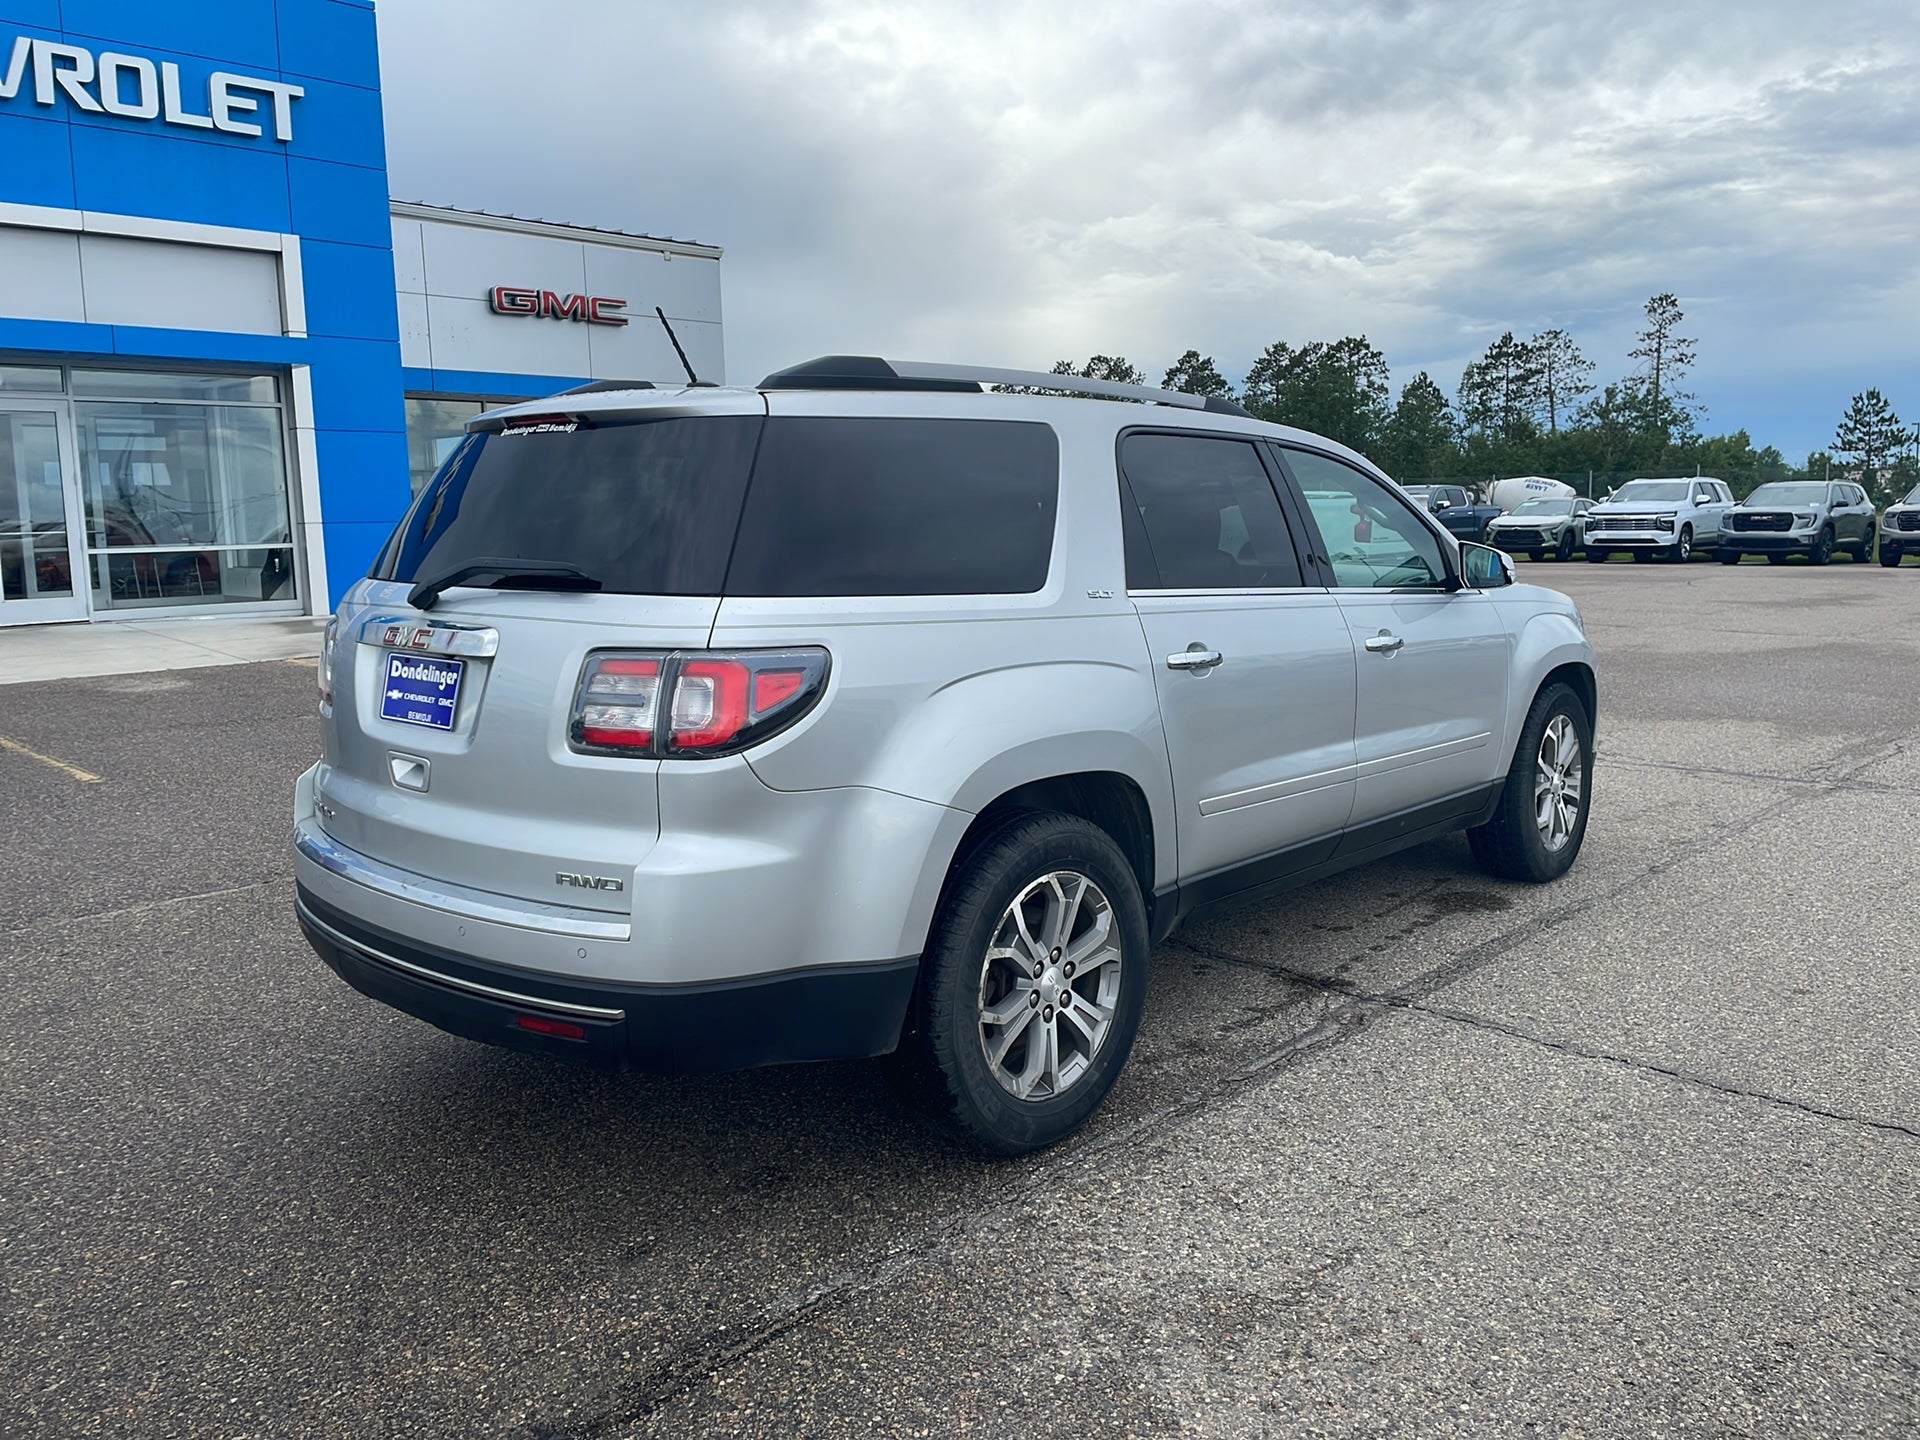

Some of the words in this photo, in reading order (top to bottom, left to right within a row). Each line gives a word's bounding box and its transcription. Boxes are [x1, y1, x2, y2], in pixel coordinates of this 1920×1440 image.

[490, 286, 628, 326] GMC
[1087, 590, 1114, 599] SLT
[383, 626, 434, 649] GMC
[390, 660, 458, 690] Dondelinger
[403, 693, 436, 704] CHEVROLET
[437, 697, 454, 707] GMC
[407, 711, 432, 722] BEMIDJI
[556, 872, 623, 891] AWD
